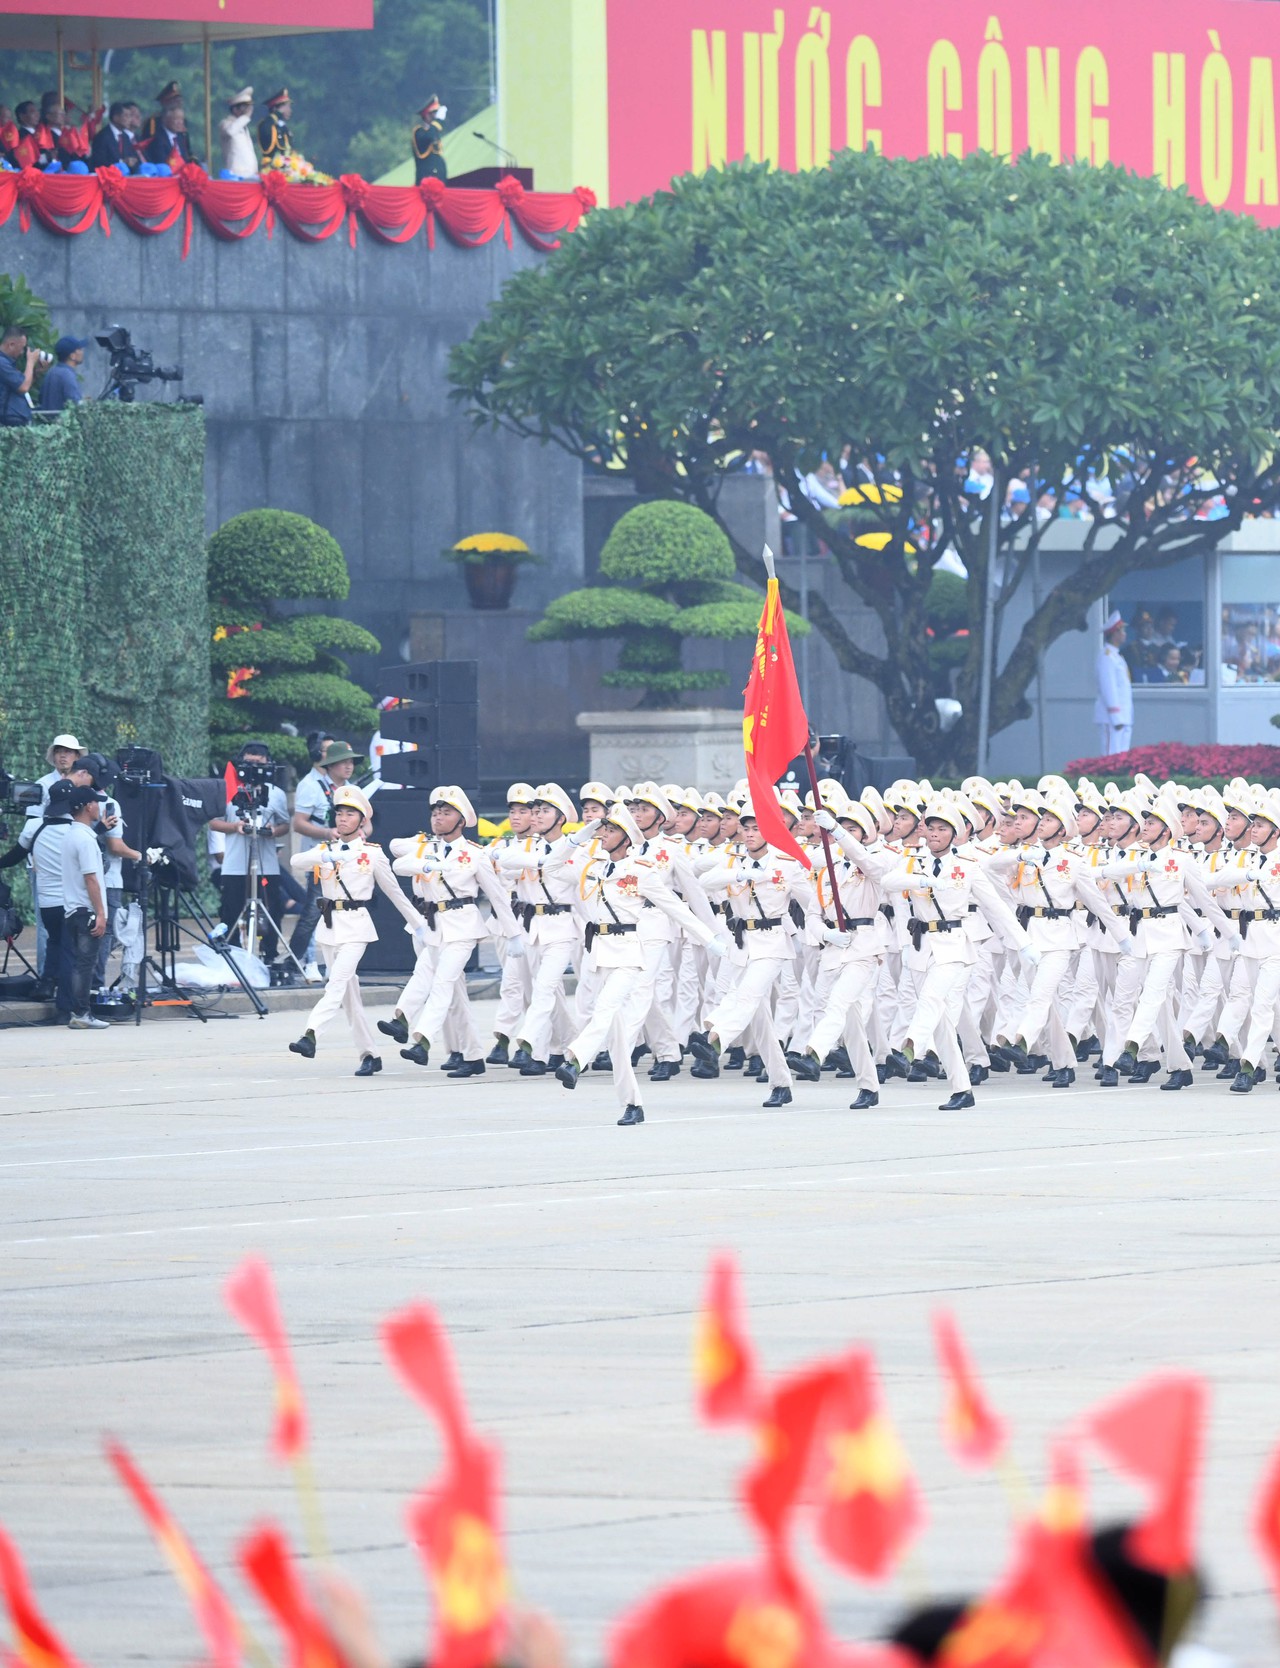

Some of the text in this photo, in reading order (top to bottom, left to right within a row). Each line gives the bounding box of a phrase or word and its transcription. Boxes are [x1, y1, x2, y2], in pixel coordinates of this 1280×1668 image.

[691, 7, 882, 176] NƯỚC
[927, 16, 1110, 168] CÔNG
[1153, 29, 1279, 206] HÒA
